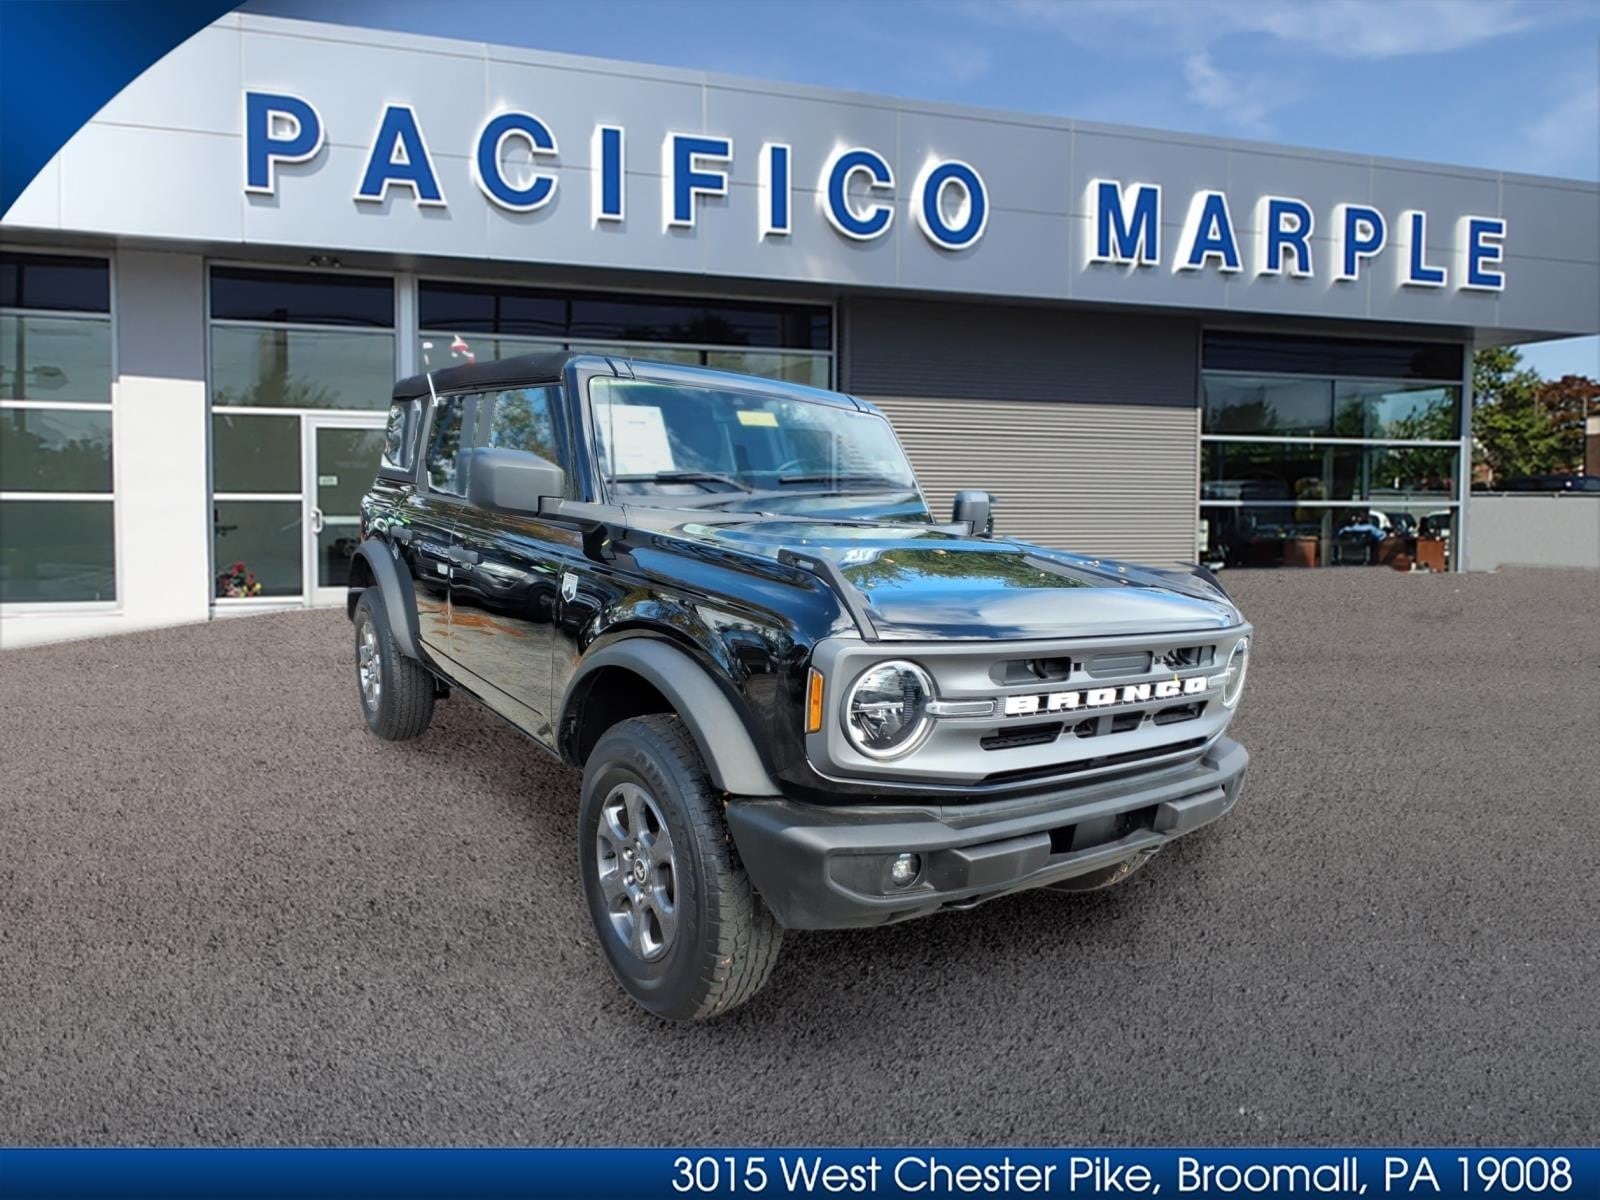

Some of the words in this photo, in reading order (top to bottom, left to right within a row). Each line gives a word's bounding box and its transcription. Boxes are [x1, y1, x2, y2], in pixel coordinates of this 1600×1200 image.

[243, 89, 988, 249] PACIFICO
[1086, 179, 1506, 290] MARPLE
[1004, 677, 1208, 715] BRONCO
